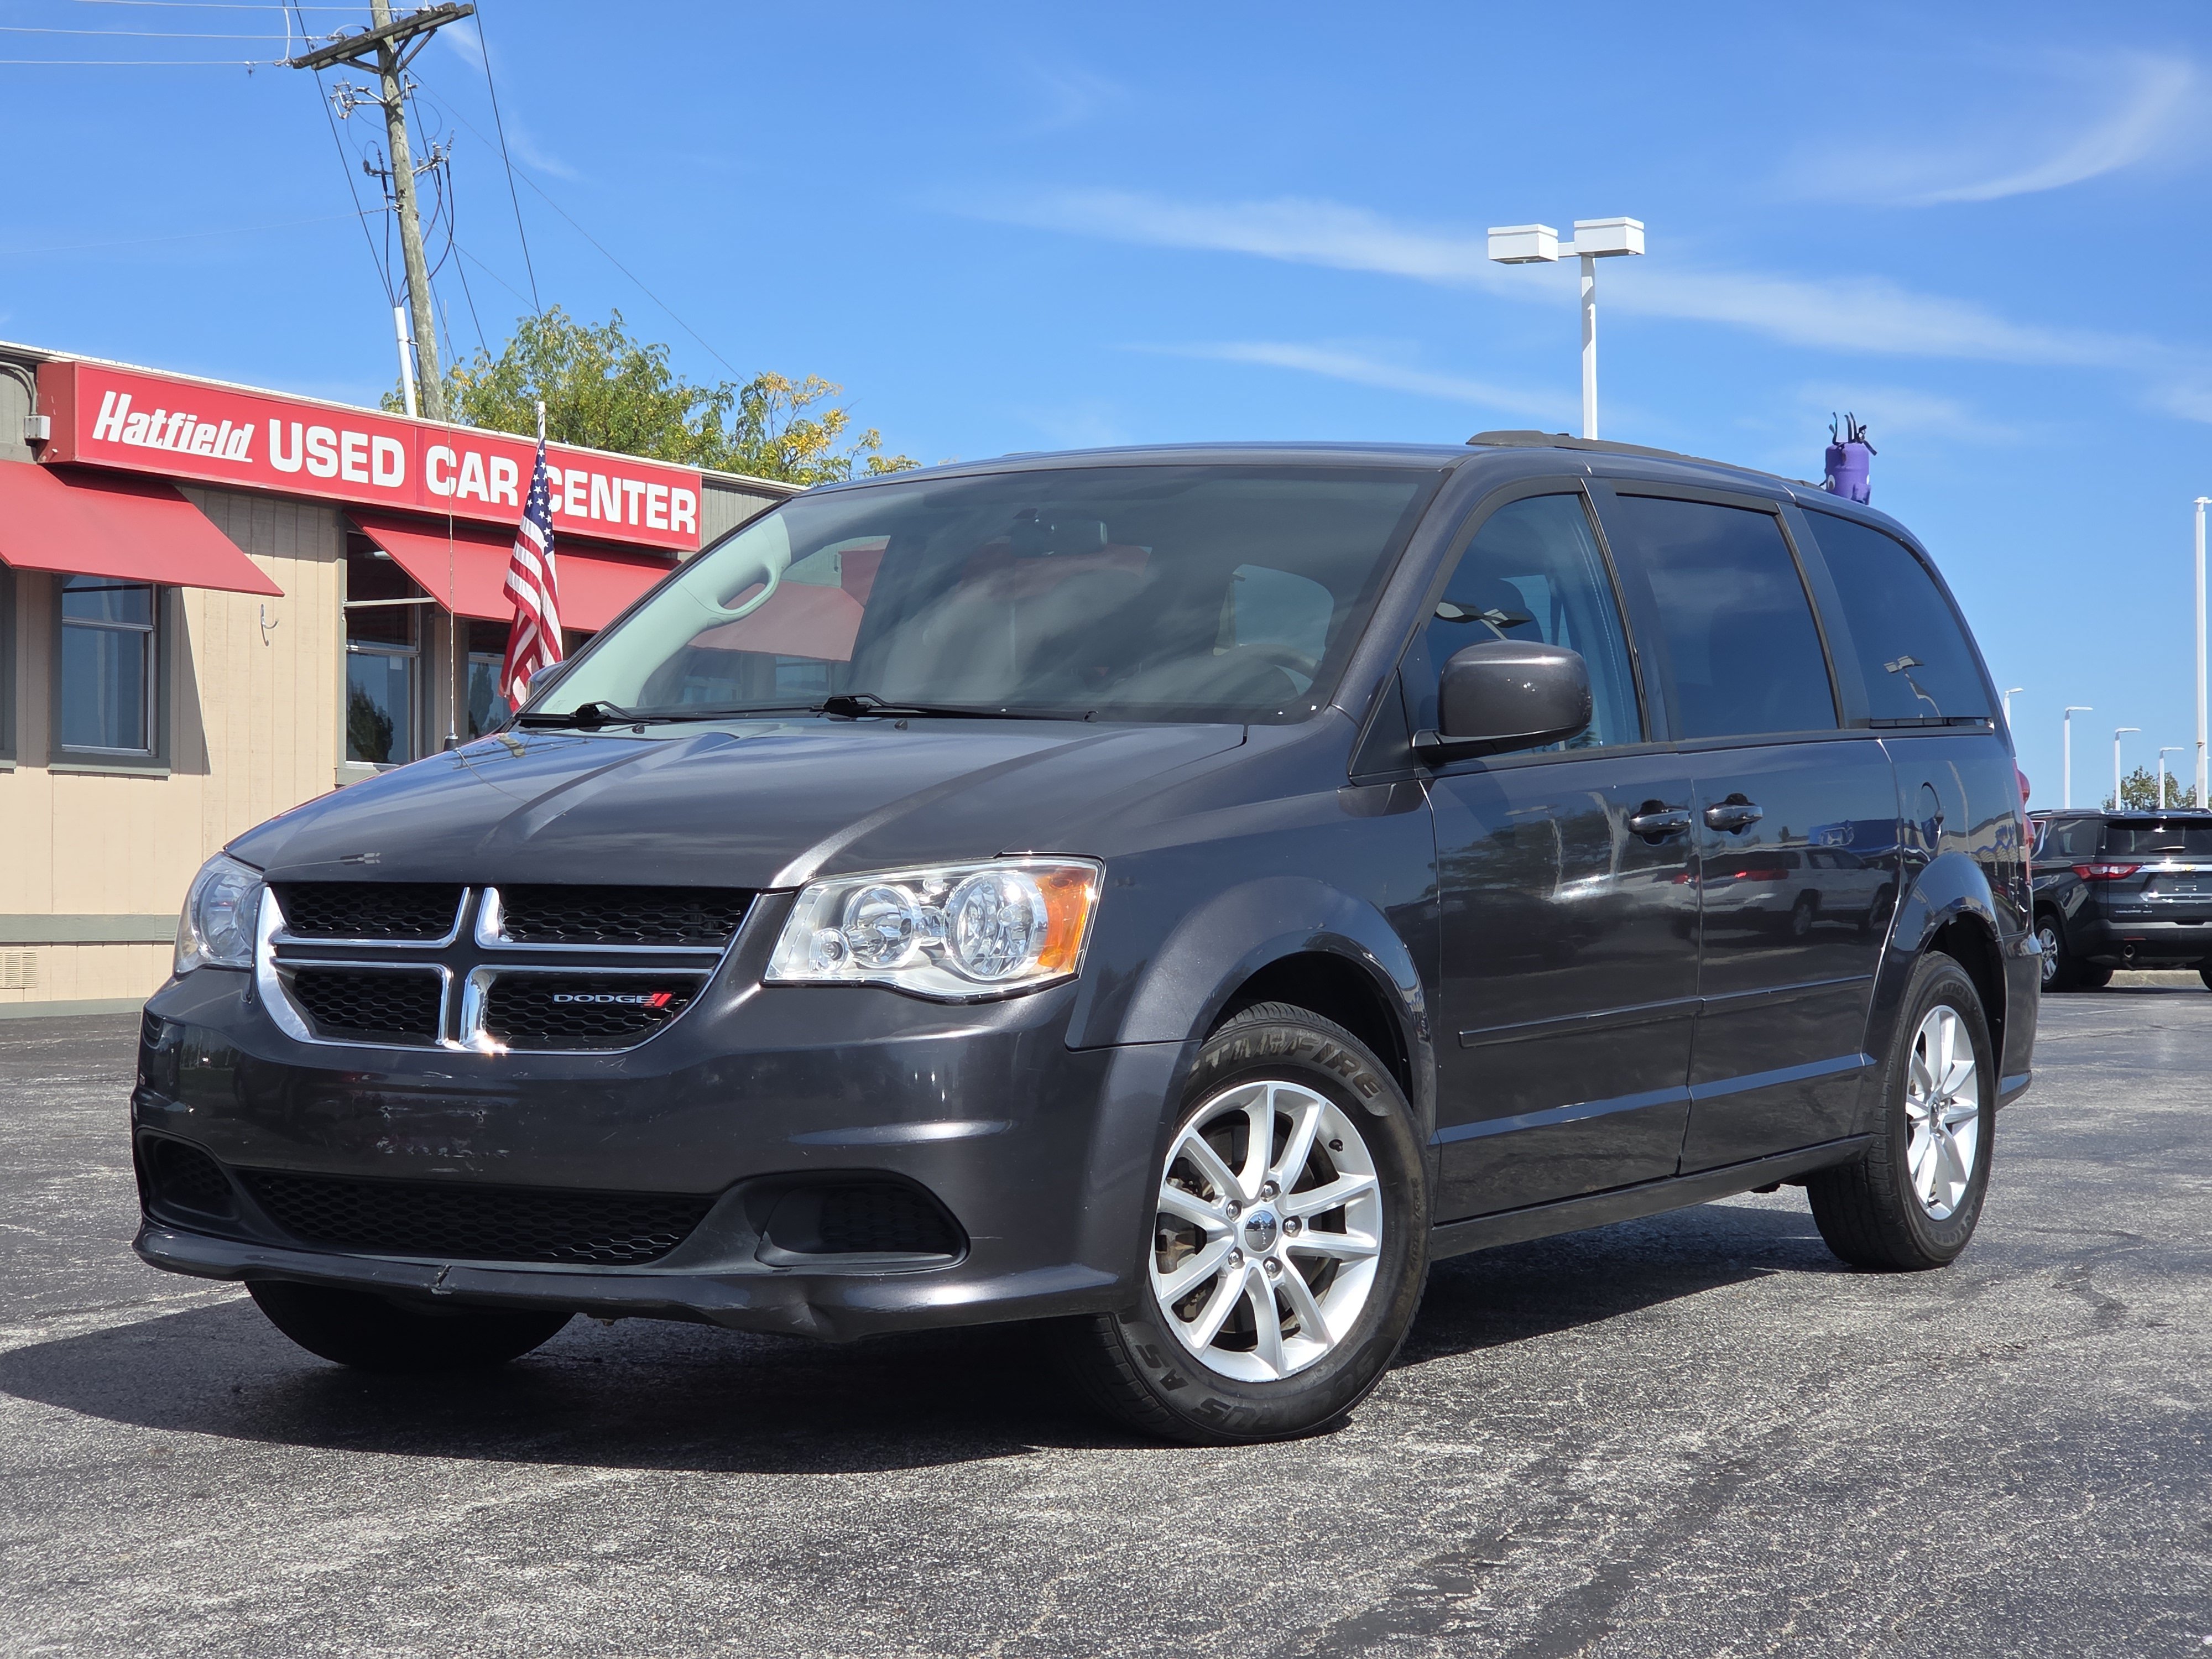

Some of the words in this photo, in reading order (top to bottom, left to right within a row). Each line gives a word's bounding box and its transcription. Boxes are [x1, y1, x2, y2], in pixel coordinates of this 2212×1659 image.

[92, 390, 254, 463] Hatfield
[269, 419, 405, 488] USED
[425, 445, 518, 506] CAR
[554, 994, 655, 1004] DODGE
